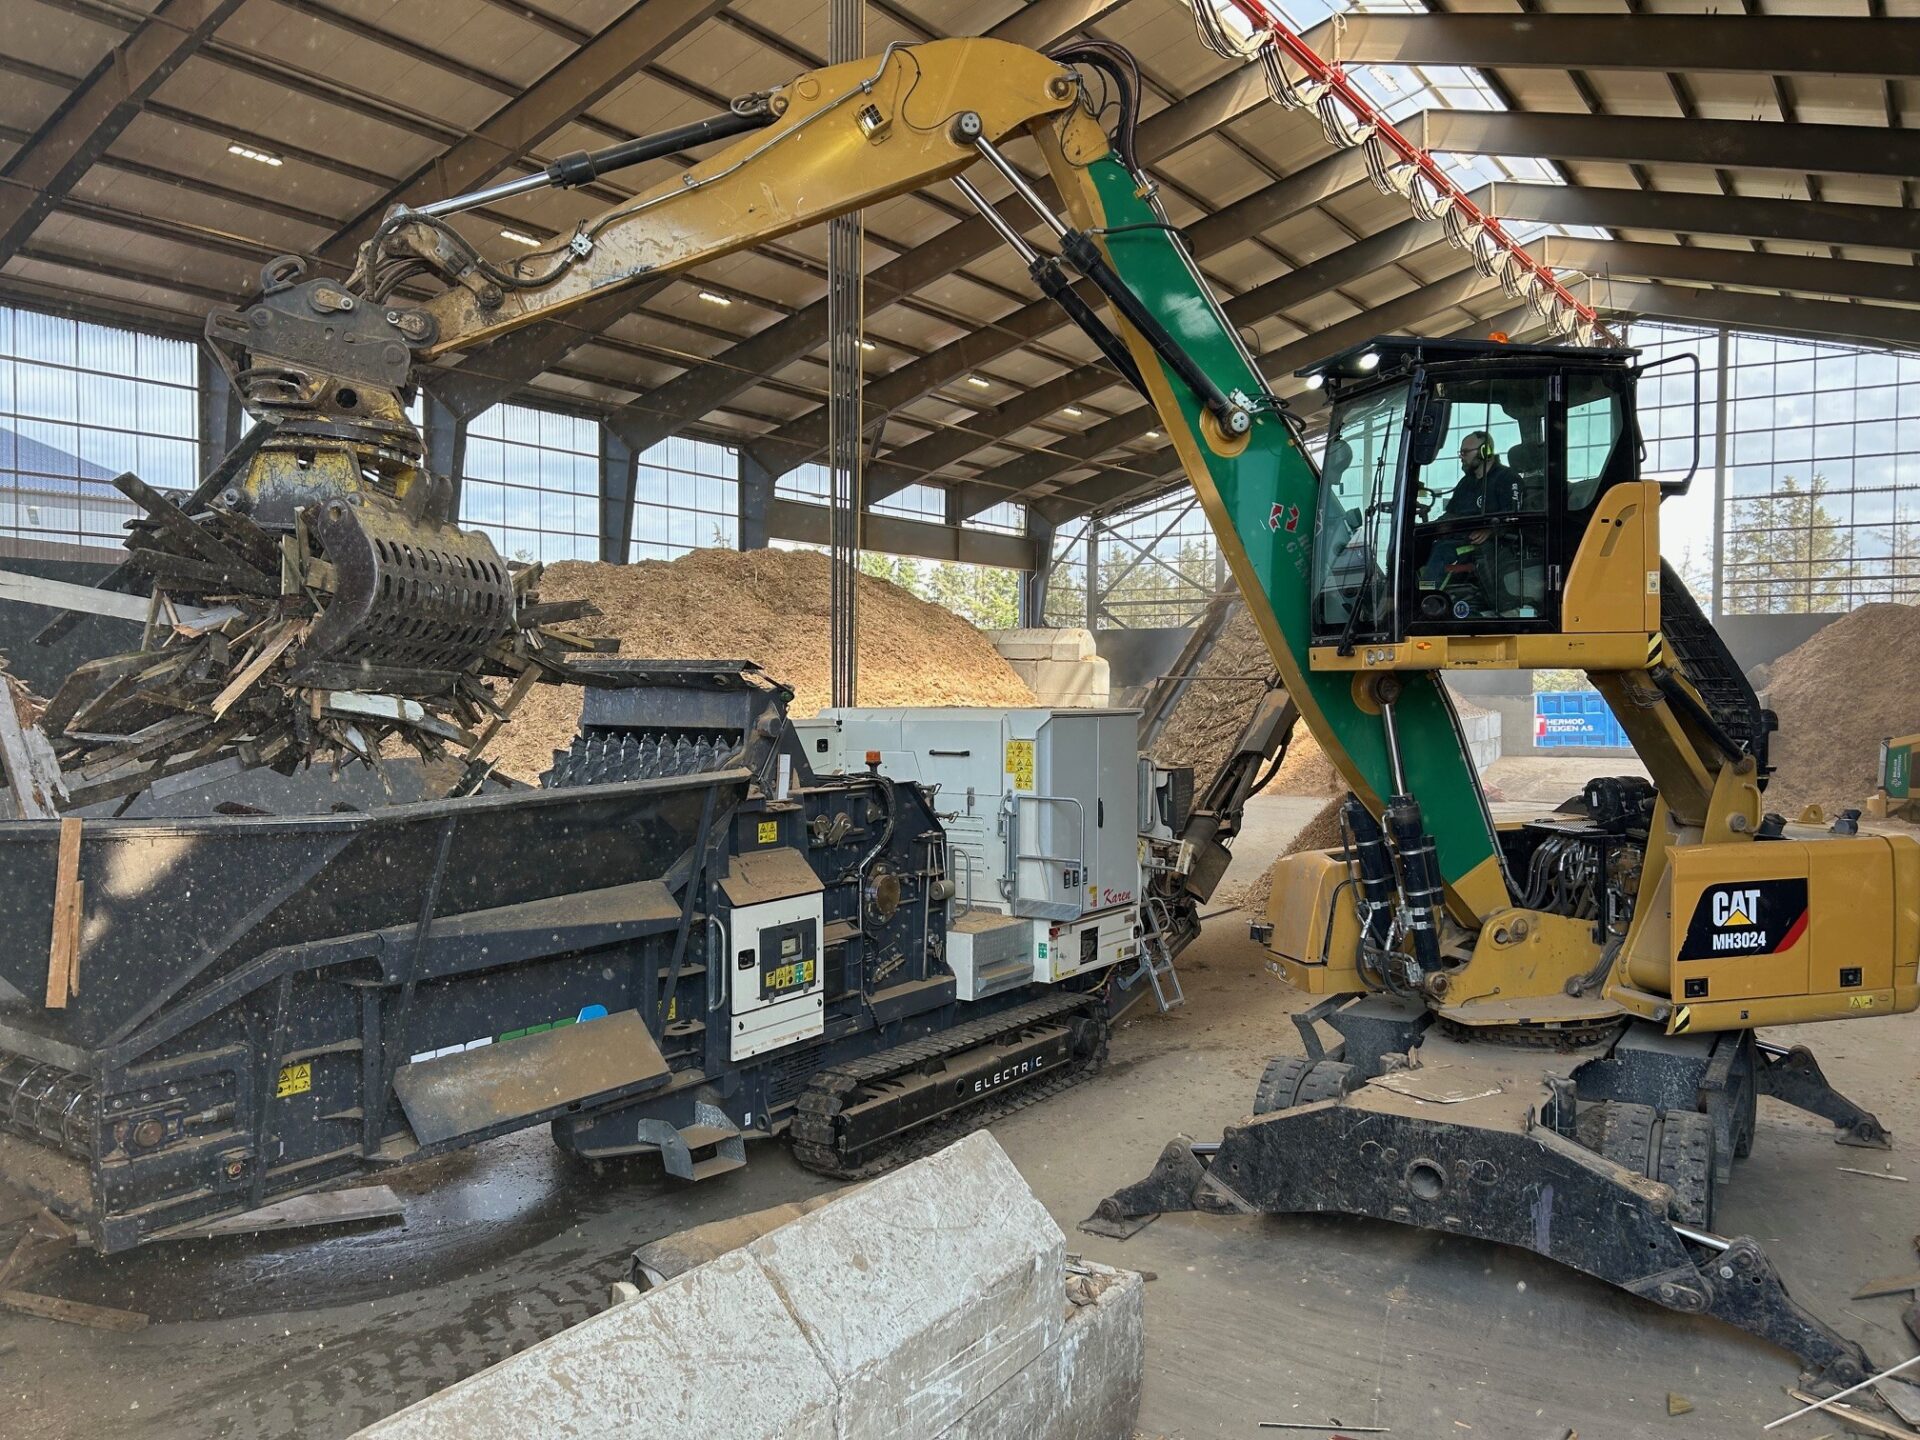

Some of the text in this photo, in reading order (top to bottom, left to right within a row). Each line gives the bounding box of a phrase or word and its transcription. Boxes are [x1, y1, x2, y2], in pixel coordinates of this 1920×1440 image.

[1103, 888, 1131, 905] Karen
[1712, 889, 1761, 927] CAT
[1712, 931, 1767, 950] MH3024
[974, 1055, 1043, 1092] ELECTRIC
